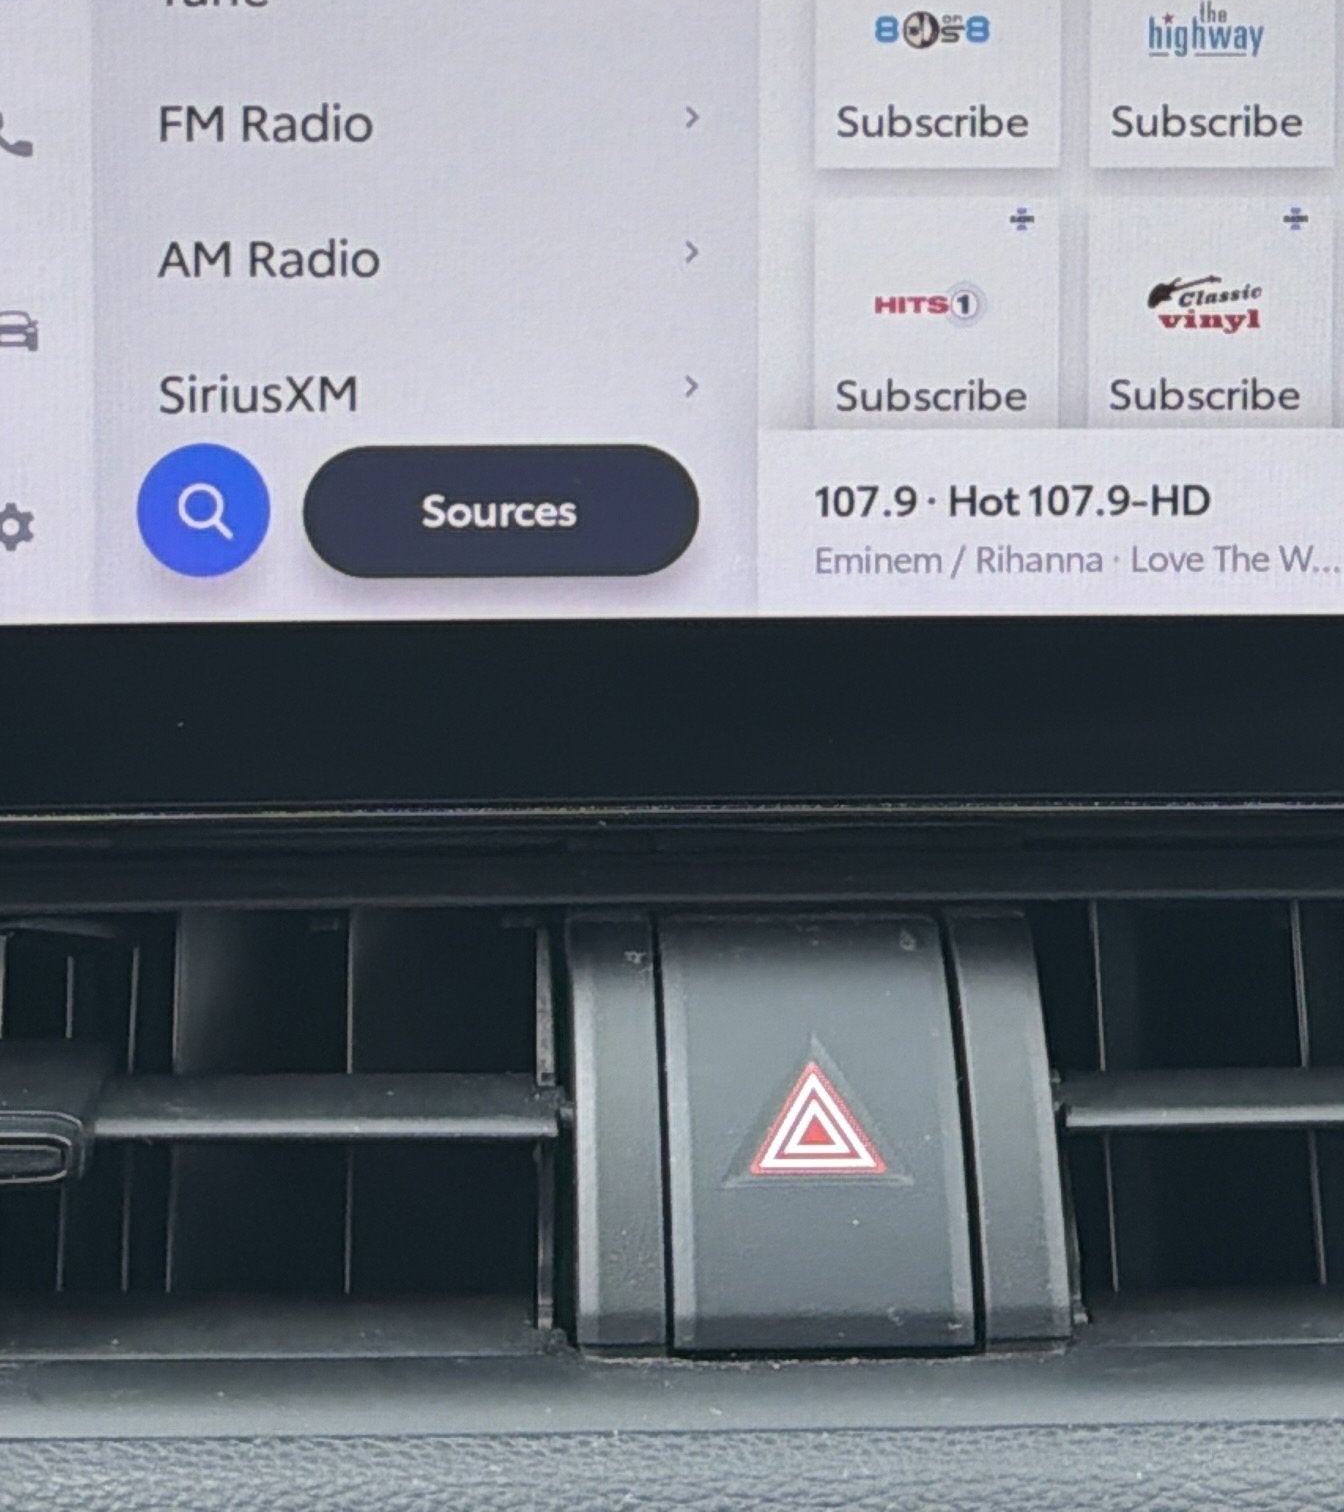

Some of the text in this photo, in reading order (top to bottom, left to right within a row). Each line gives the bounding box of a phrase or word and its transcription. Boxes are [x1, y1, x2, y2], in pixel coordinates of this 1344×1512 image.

[1199, 0, 1228, 23] the
[1148, 15, 1264, 57] highway
[159, 102, 373, 143] FM Radio
[837, 103, 1029, 138] Subscribe
[1111, 103, 1303, 138] Subscribe
[157, 237, 380, 279] AM Radio
[1178, 283, 1262, 308] Classic
[1158, 308, 1261, 334] vinyl
[159, 373, 357, 415] SiriusXM
[836, 378, 1027, 412] Subscribe
[1109, 377, 1300, 411] Subscribe
[422, 493, 577, 529] Sources
[815, 484, 1211, 518] 107.9 Hot 107.9-HD
[815, 545, 943, 575] Eminem
[976, 544, 1103, 574] Rihanna
[1132, 545, 1205, 573] Love
[1212, 543, 1270, 573] The
